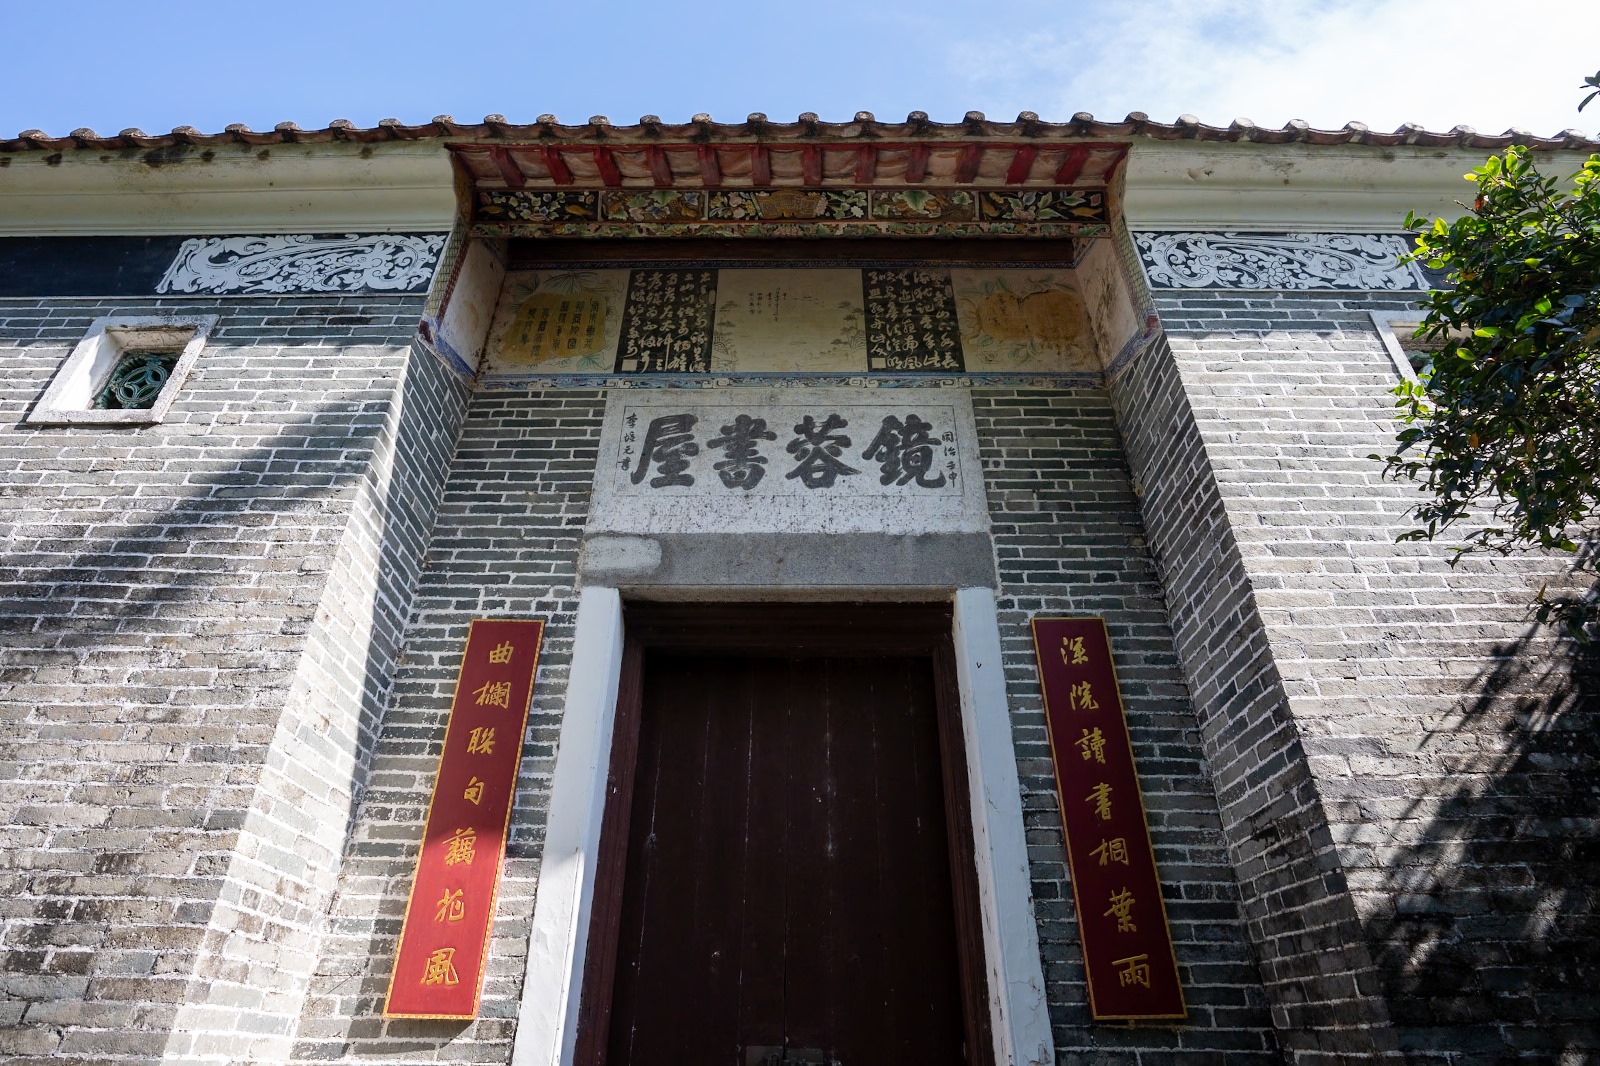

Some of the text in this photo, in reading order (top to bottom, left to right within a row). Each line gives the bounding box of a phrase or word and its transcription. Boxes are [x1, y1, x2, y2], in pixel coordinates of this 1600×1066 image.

[631, 413, 949, 489] 鏡蓉書屋
[1059, 635, 1151, 989] 深院讀書桐葉雨
